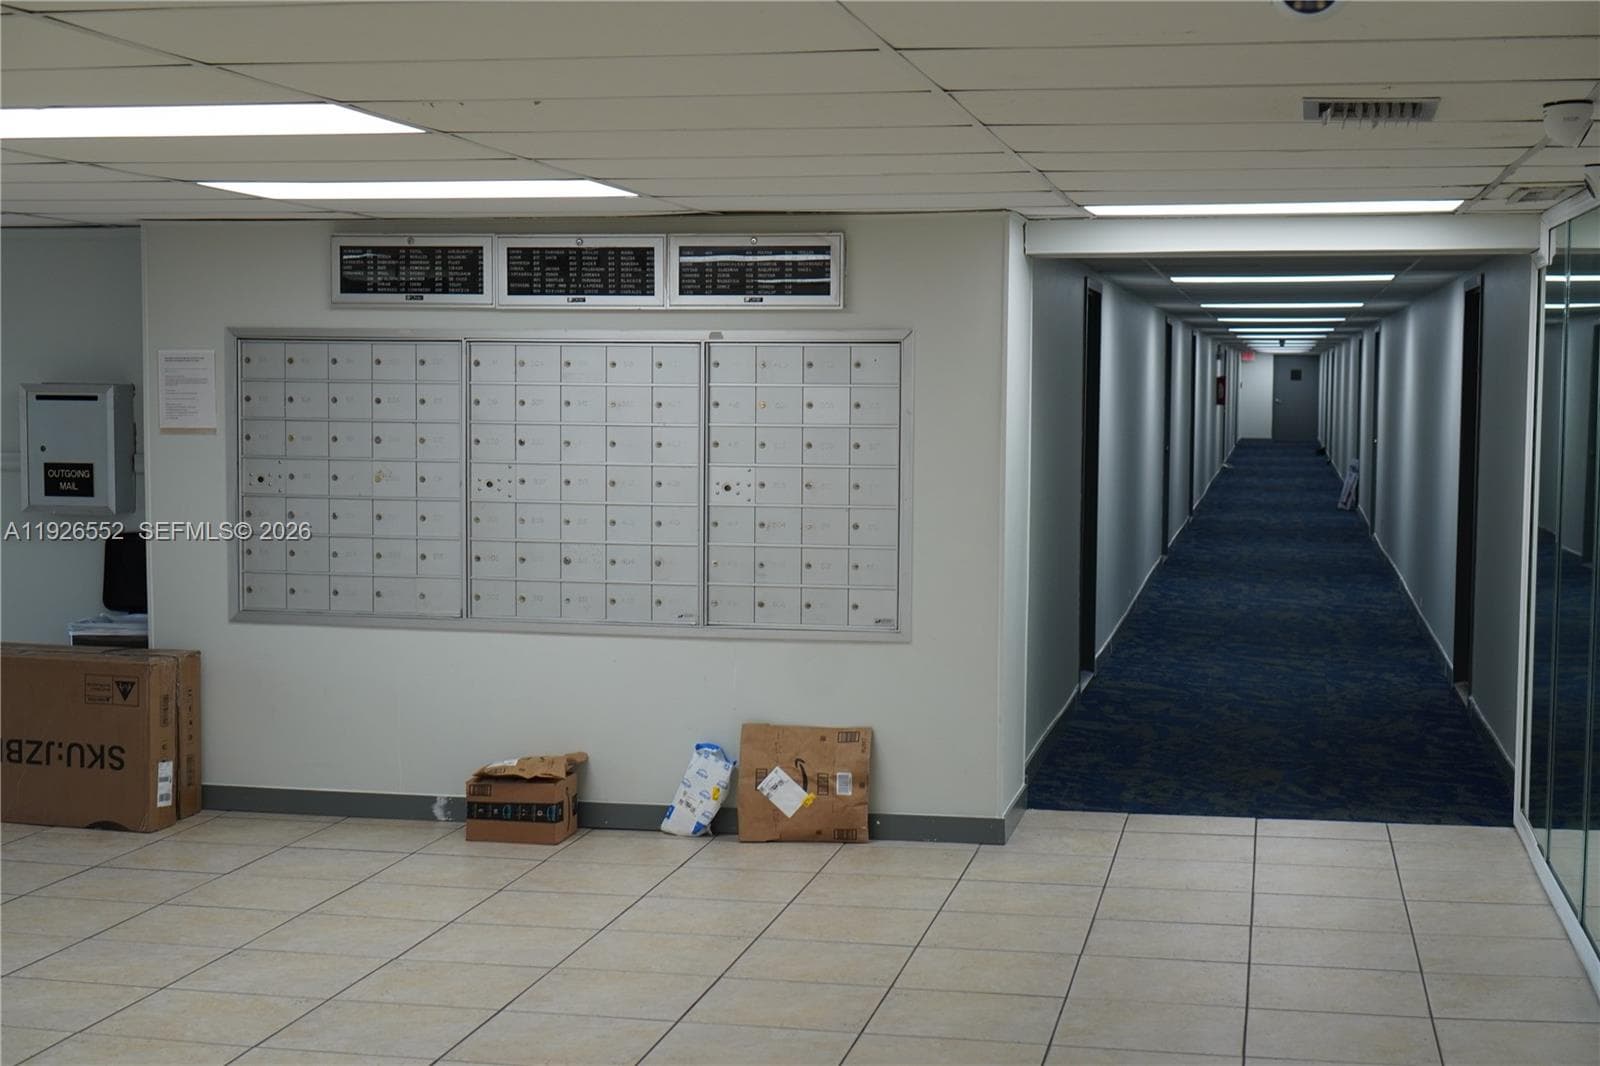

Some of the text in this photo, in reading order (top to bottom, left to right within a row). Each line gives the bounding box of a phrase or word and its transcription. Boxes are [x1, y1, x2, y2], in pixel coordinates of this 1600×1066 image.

[47, 468, 91, 479] OUTGOING
[59, 481, 79, 491] MAIL
[1, 738, 126, 772] SKU:JZB
